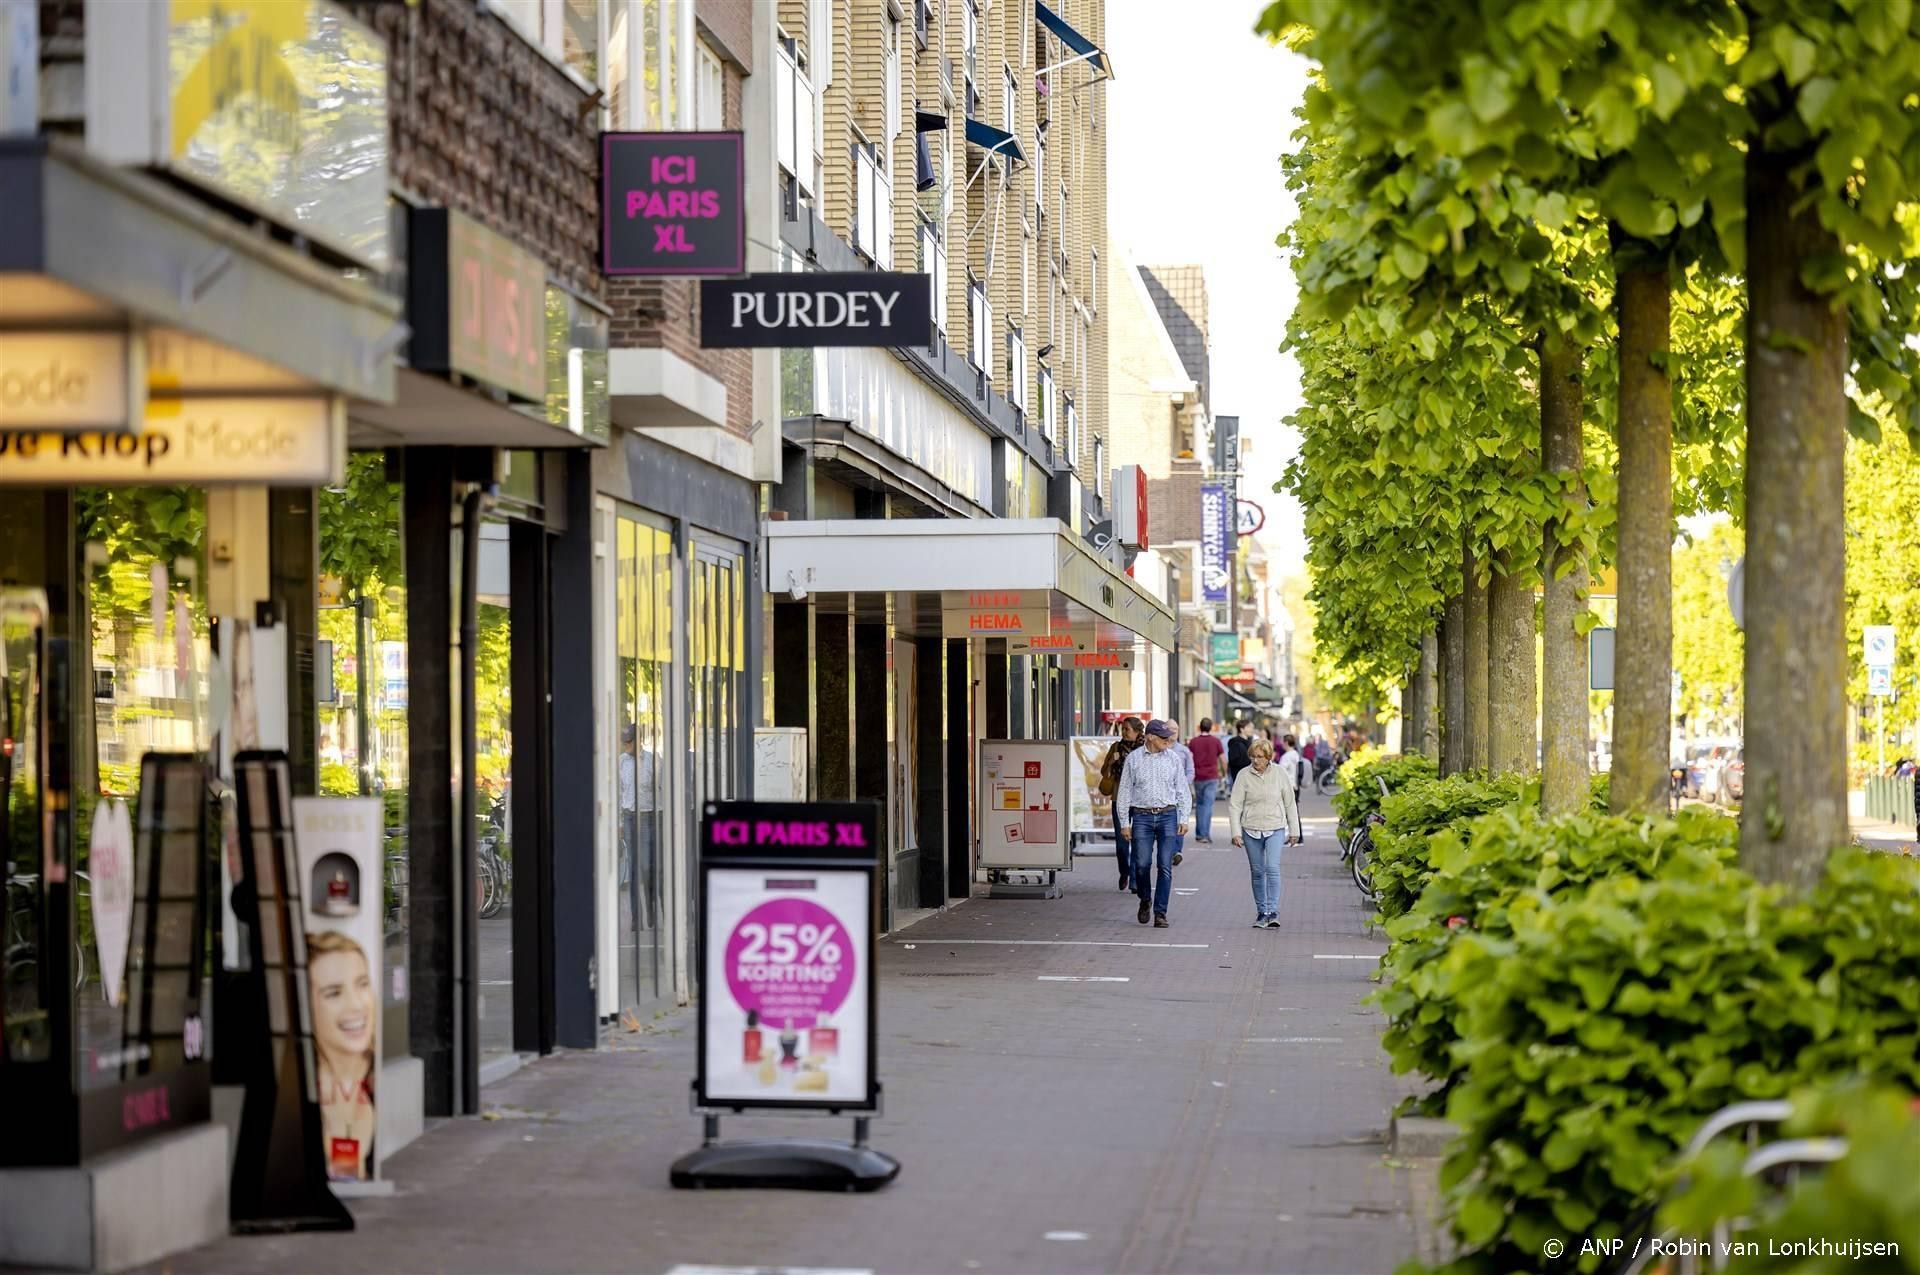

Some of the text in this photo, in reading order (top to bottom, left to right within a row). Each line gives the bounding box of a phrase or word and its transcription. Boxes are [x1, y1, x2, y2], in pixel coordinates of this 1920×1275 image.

[650, 156, 695, 184] ICI
[625, 190, 720, 220] PARIS
[653, 224, 695, 253] XL
[731, 291, 901, 329] PURDEY
[184, 417, 298, 460] Mode
[970, 614, 1022, 629] HEMA
[1030, 635, 1073, 648] HEMA
[1075, 654, 1120, 666] HEMA
[711, 820, 867, 847] ICI PARIS XL
[738, 923, 842, 965] 25%
